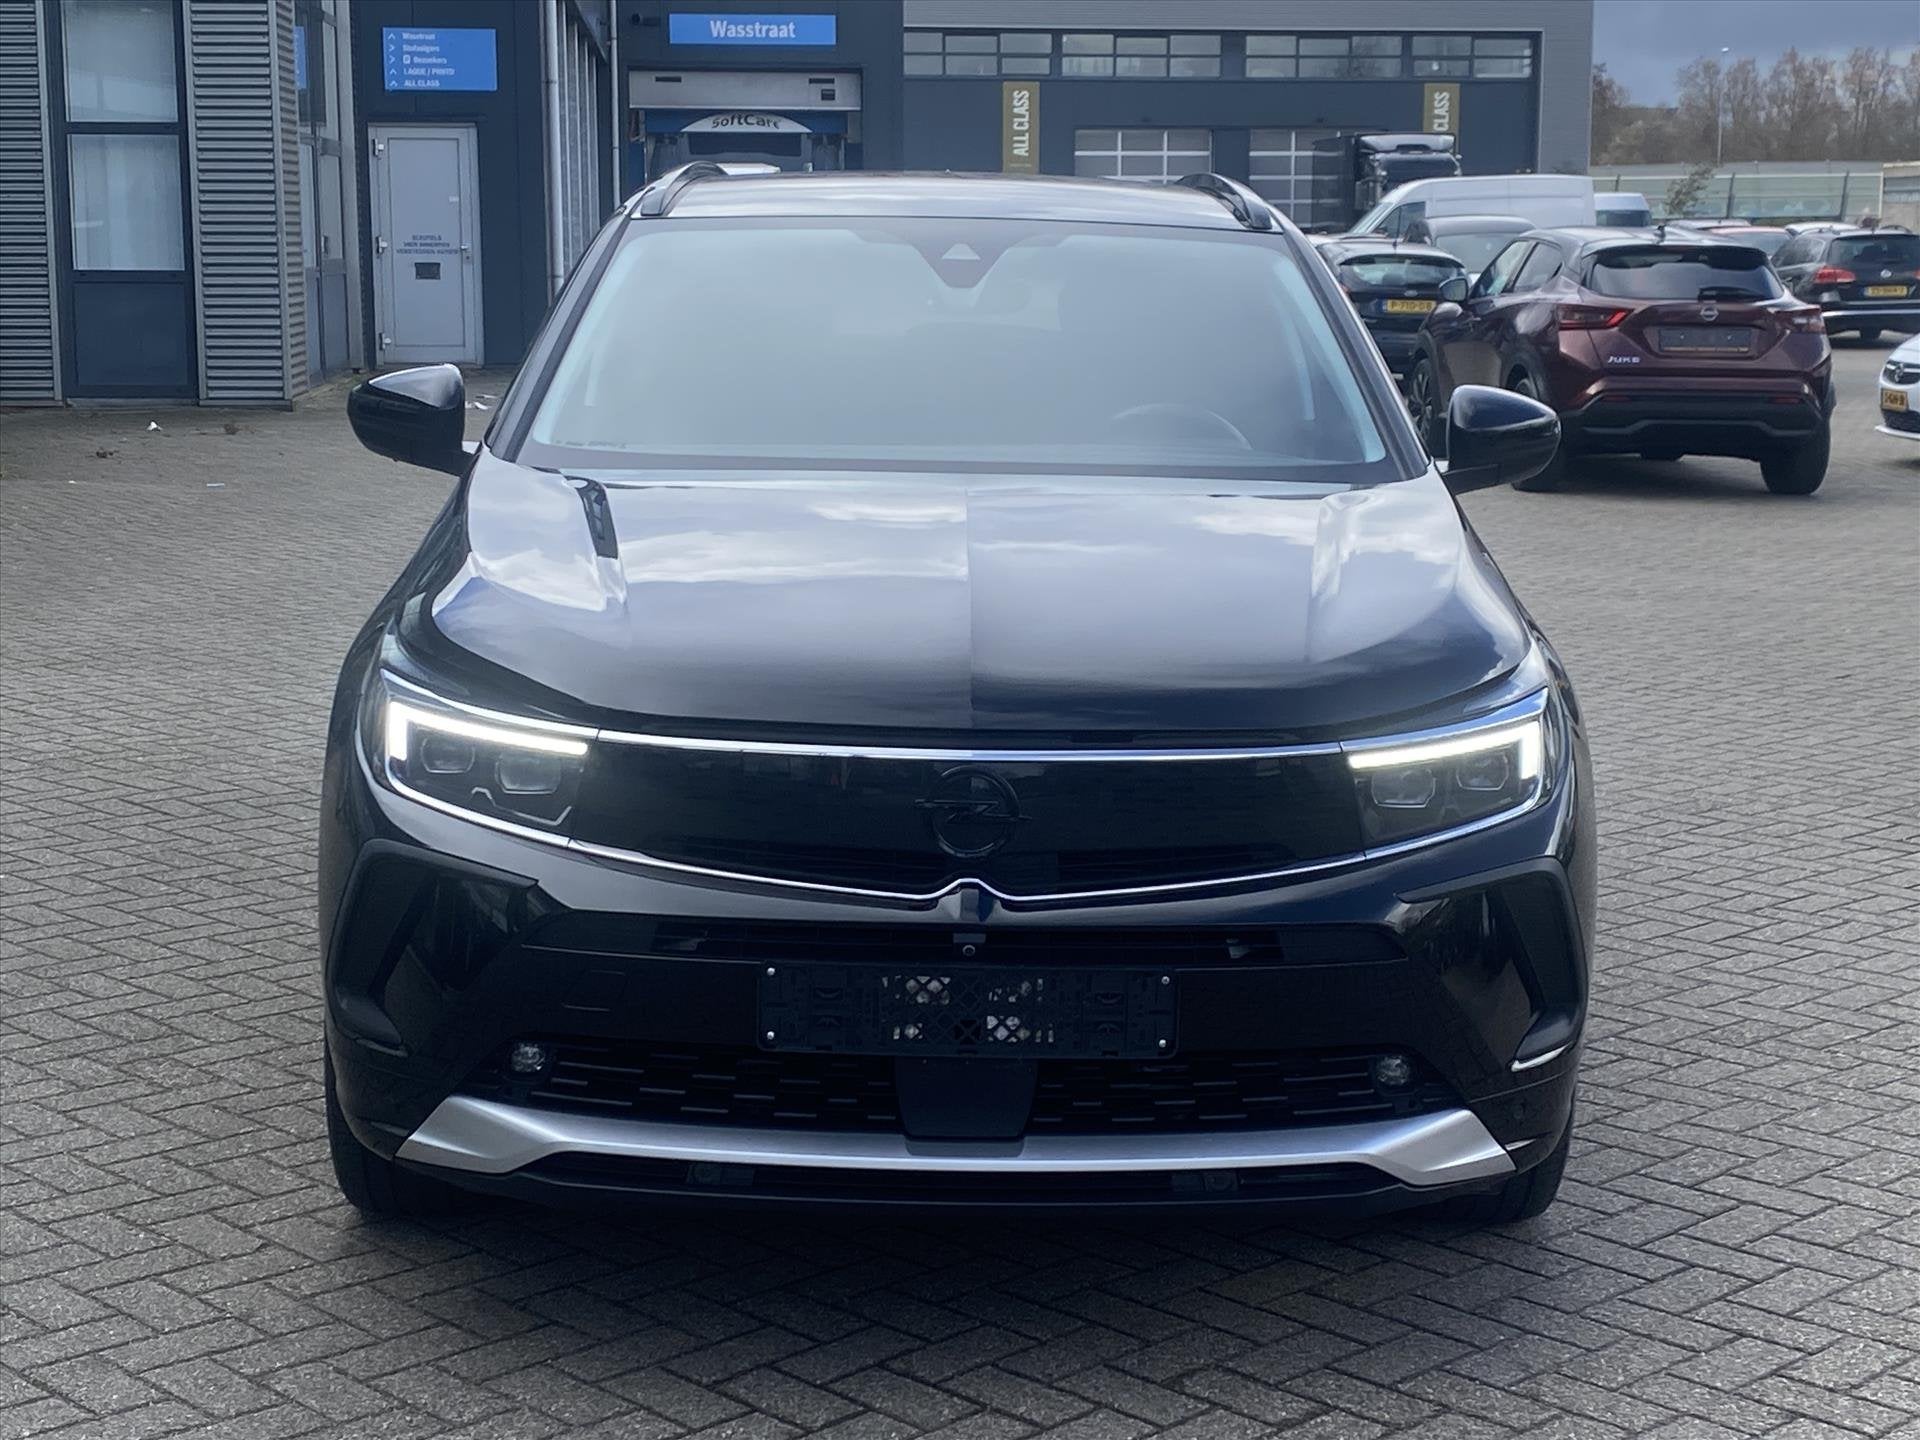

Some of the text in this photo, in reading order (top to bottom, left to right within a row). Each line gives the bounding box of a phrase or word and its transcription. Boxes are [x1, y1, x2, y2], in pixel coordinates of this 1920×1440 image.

[710, 20, 796, 38] Wasstraat
[417, 79, 440, 87] CLASS
[1012, 90, 1029, 156] ALL CLASS
[1433, 91, 1450, 131] CLASS
